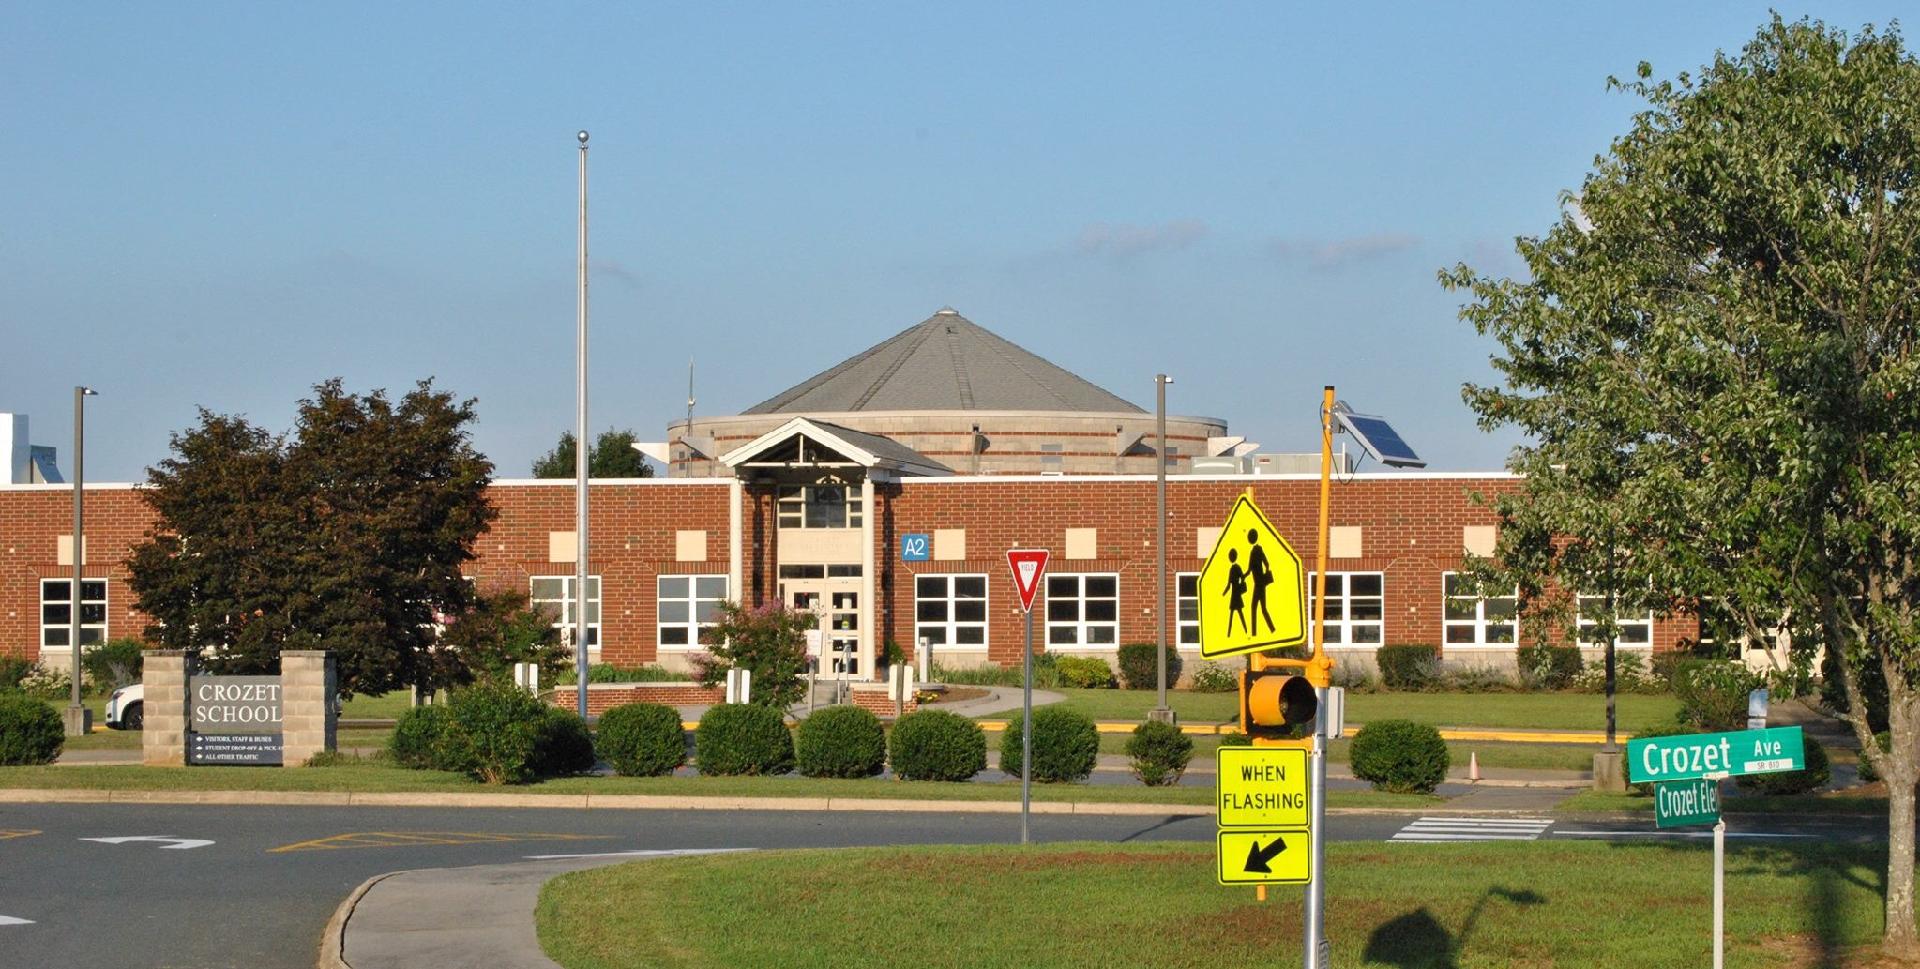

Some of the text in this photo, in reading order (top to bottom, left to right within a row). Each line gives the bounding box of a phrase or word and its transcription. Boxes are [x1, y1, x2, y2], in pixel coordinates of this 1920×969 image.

[904, 538, 925, 556] A2
[1021, 564, 1035, 572] YIELD
[199, 684, 281, 701] CROZET
[196, 705, 283, 723] SCHOOL
[1643, 737, 1782, 775] Crozet Ave
[1241, 765, 1286, 781] WHEN
[1223, 793, 1304, 810] FLASHING
[1659, 783, 1698, 818] Crozet
